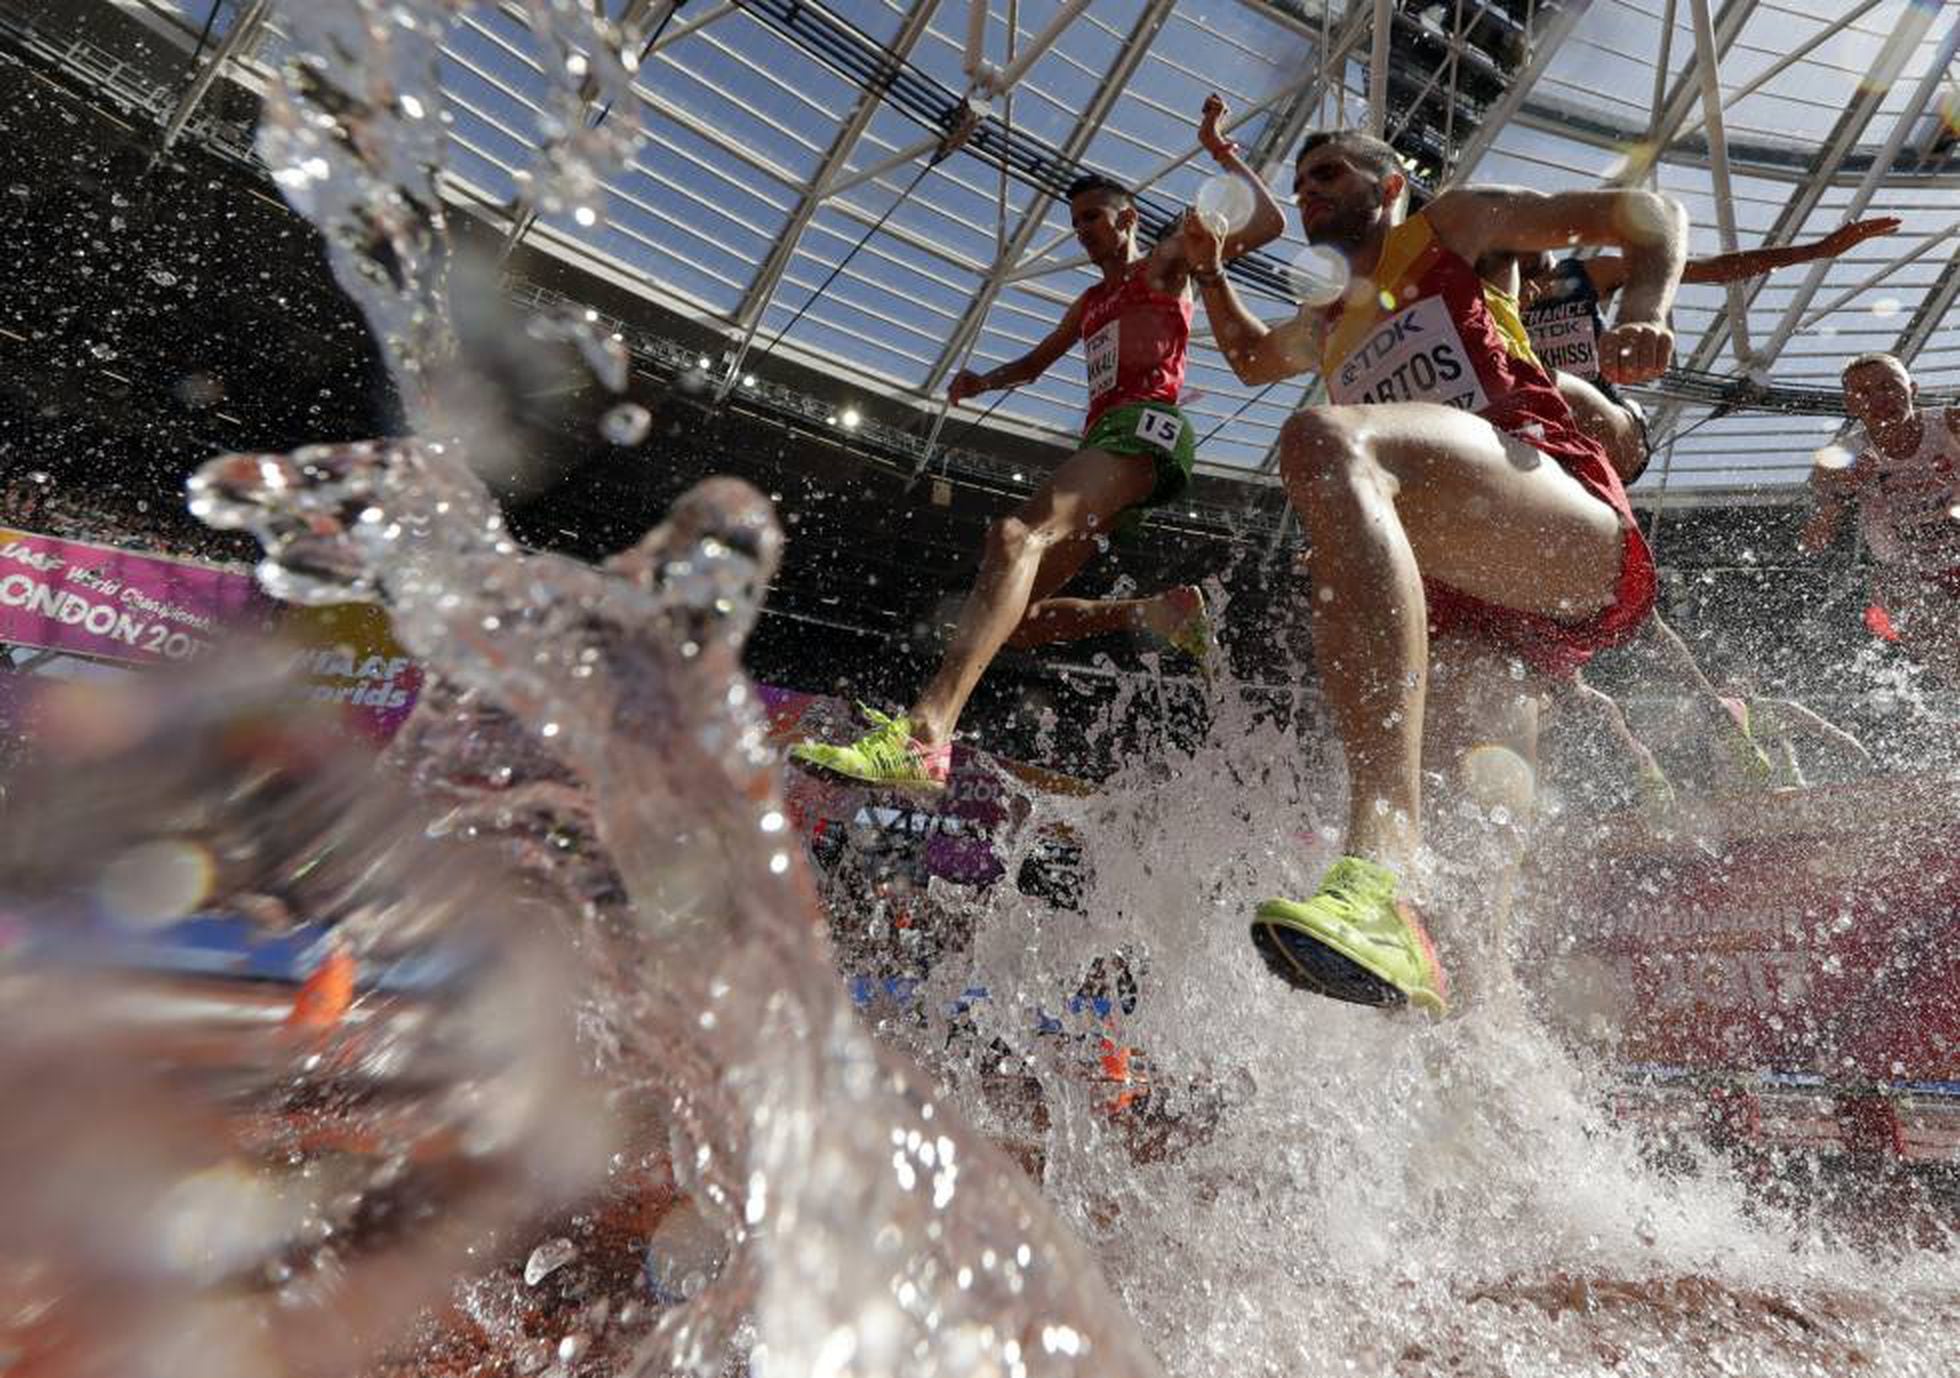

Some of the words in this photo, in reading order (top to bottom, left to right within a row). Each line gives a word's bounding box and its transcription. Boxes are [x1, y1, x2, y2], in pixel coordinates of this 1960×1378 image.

[1352, 311, 1424, 370] TDK
[1533, 320, 1579, 338] TDK
[1145, 413, 1176, 441] 15
[66, 565, 123, 596] World
